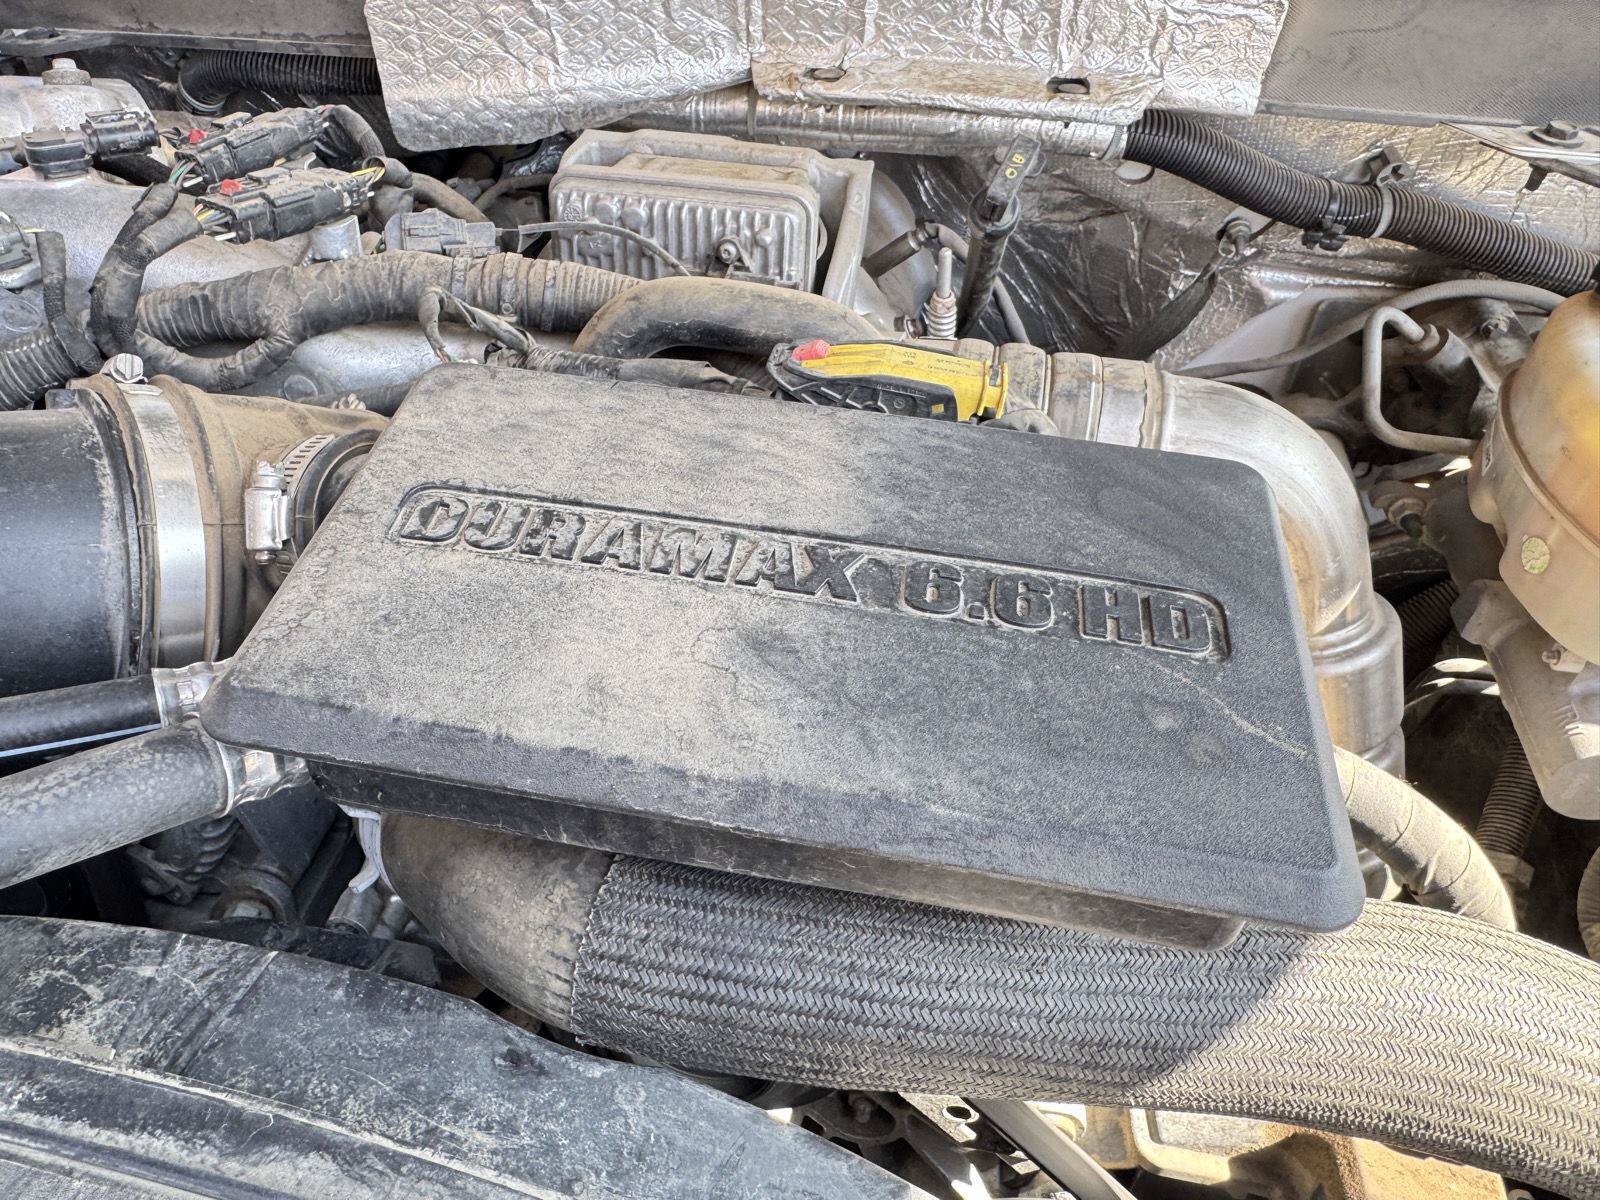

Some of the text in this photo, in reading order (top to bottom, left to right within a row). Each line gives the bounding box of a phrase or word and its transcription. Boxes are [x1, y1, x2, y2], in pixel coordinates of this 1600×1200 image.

[399, 498, 1212, 655] DURAMAX 6.6 HD
